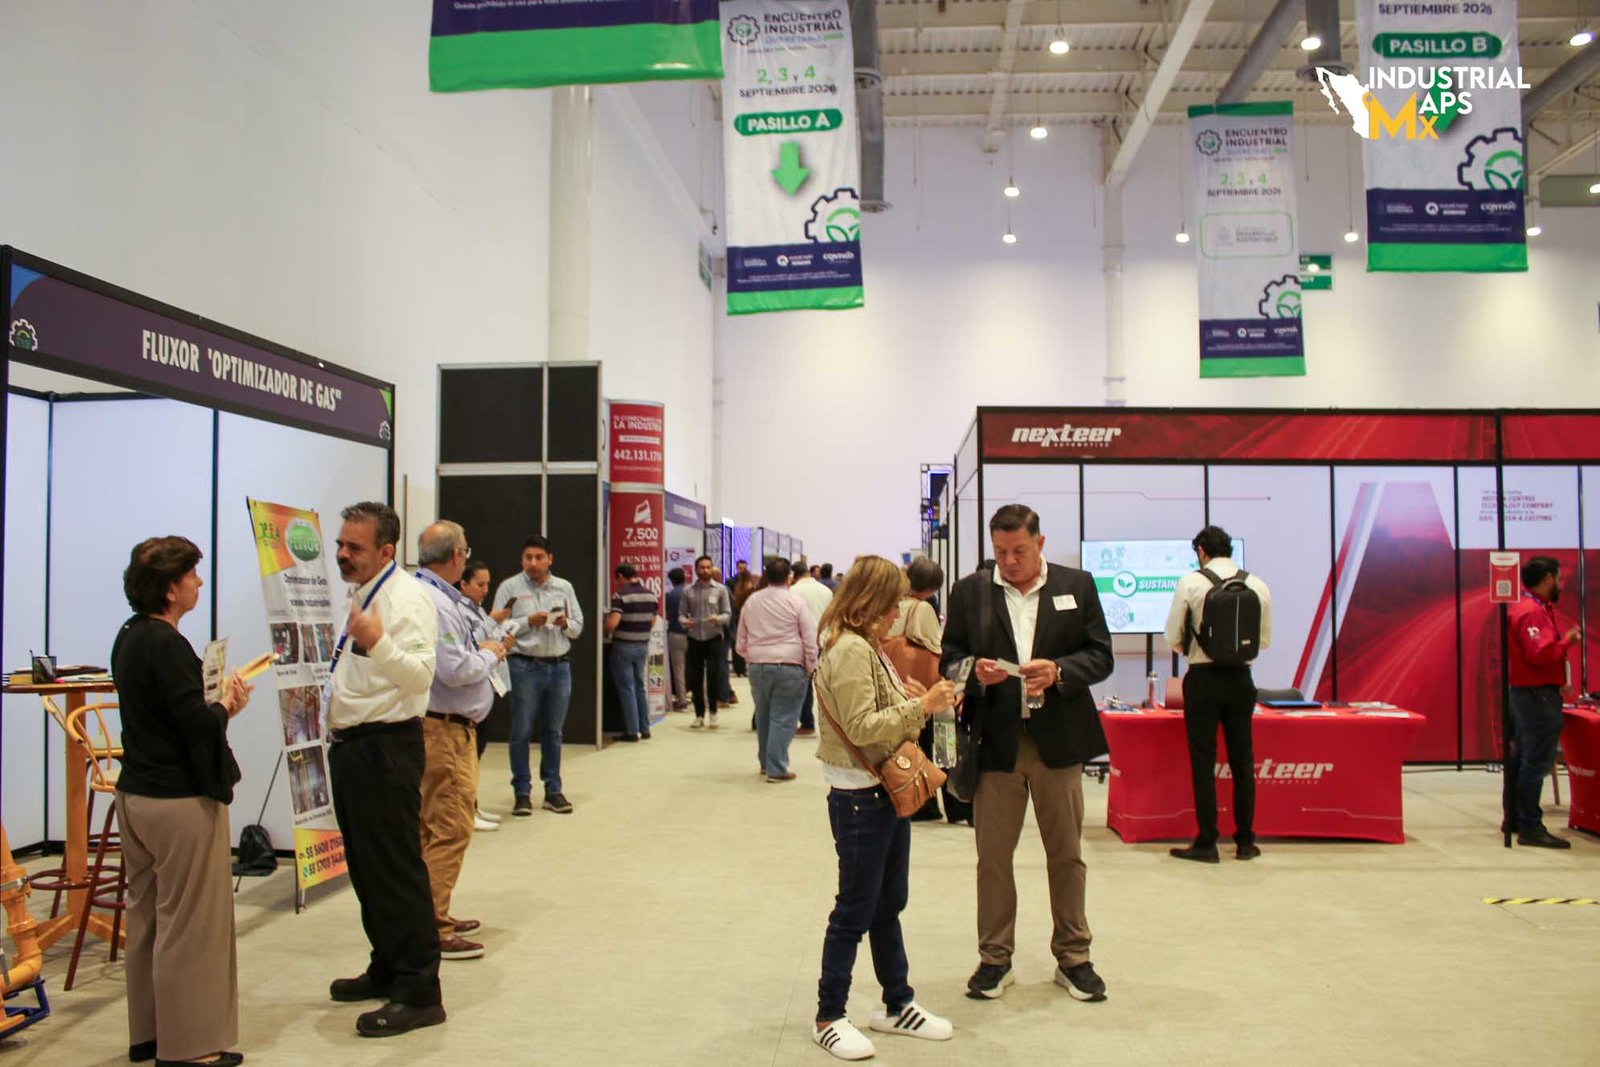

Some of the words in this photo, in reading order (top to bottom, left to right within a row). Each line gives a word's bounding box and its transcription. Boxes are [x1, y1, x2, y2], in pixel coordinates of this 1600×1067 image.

[763, 9, 842, 23] ENCUENTRO
[1378, 3, 1460, 15] SEPTIEMBRE
[764, 21, 844, 34] INDUSTRIAL
[1389, 37, 1466, 53] PASILLO
[1472, 36, 1488, 52] B
[777, 67, 788, 81] 3
[804, 65, 816, 78] 4
[739, 85, 806, 97] SEPTIEMBRE
[747, 114, 812, 132] PASILLO
[815, 111, 831, 128] A
[1225, 127, 1288, 138] ENCUENTRO
[1225, 137, 1288, 147] INDUSTRIAL
[142, 329, 199, 373] FLUXOR
[300, 378, 314, 405] DE
[1011, 424, 1122, 447] nexteer
[625, 527, 659, 541] 7,500
